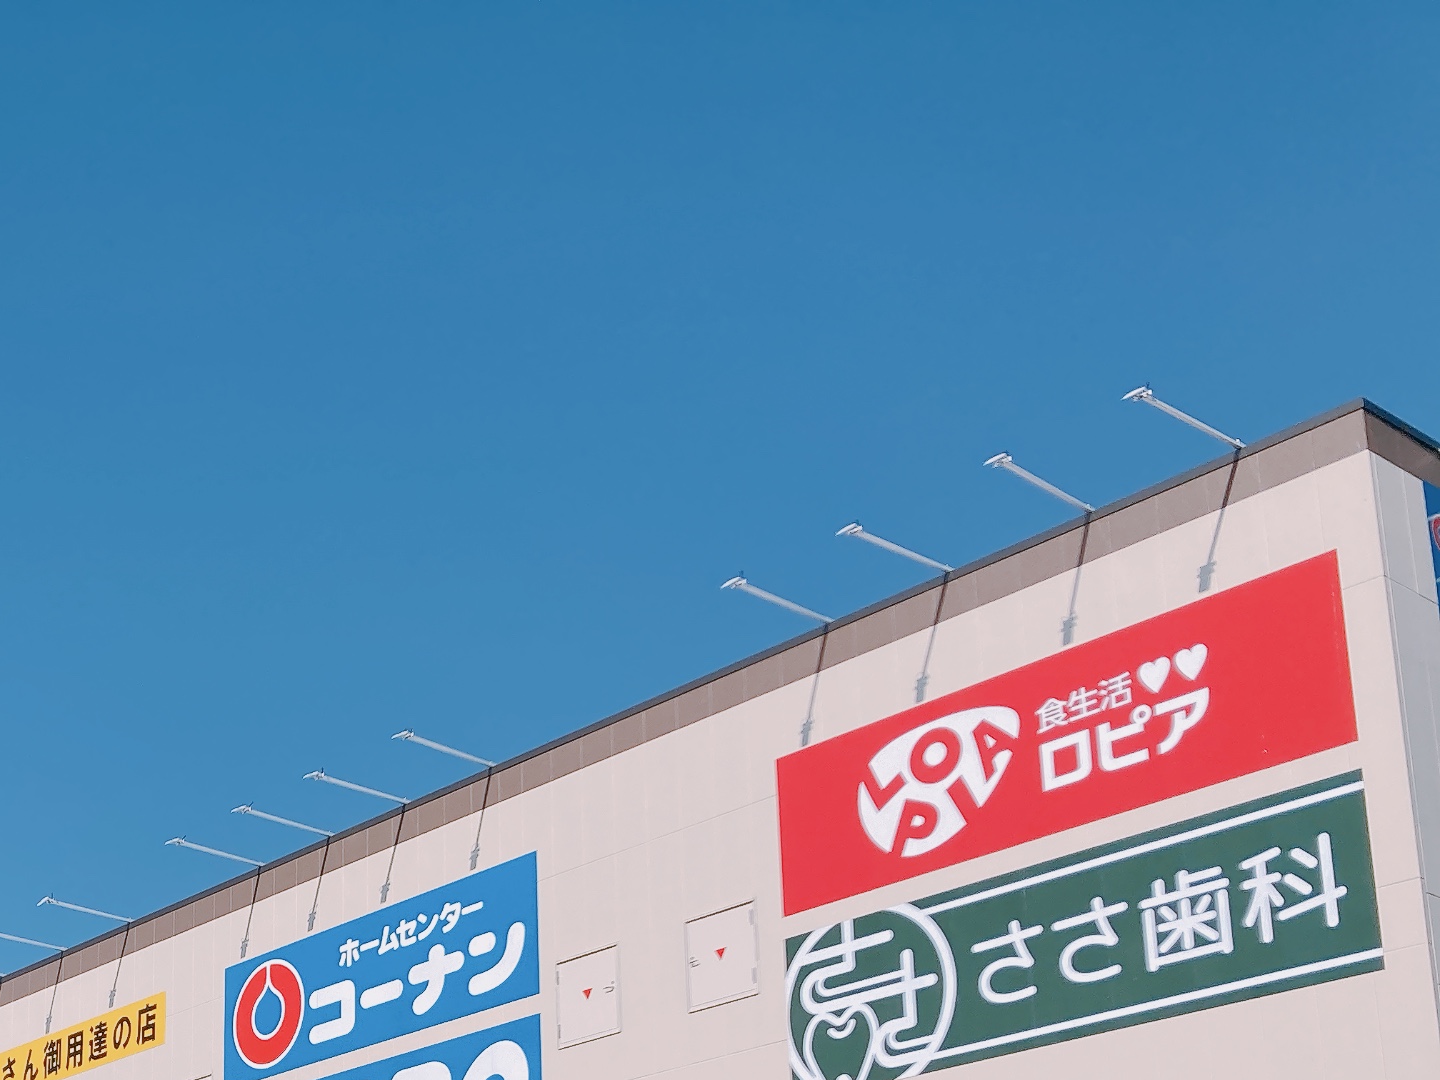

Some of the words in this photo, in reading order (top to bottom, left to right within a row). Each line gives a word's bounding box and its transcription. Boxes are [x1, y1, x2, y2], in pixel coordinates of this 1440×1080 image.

[1034, 671, 1132, 734] 食生活
[1038, 687, 1210, 793] ロピア
[338, 900, 485, 968] ホームセンター
[970, 832, 1348, 1005] ささ歯科
[308, 921, 527, 1046] コーナン
